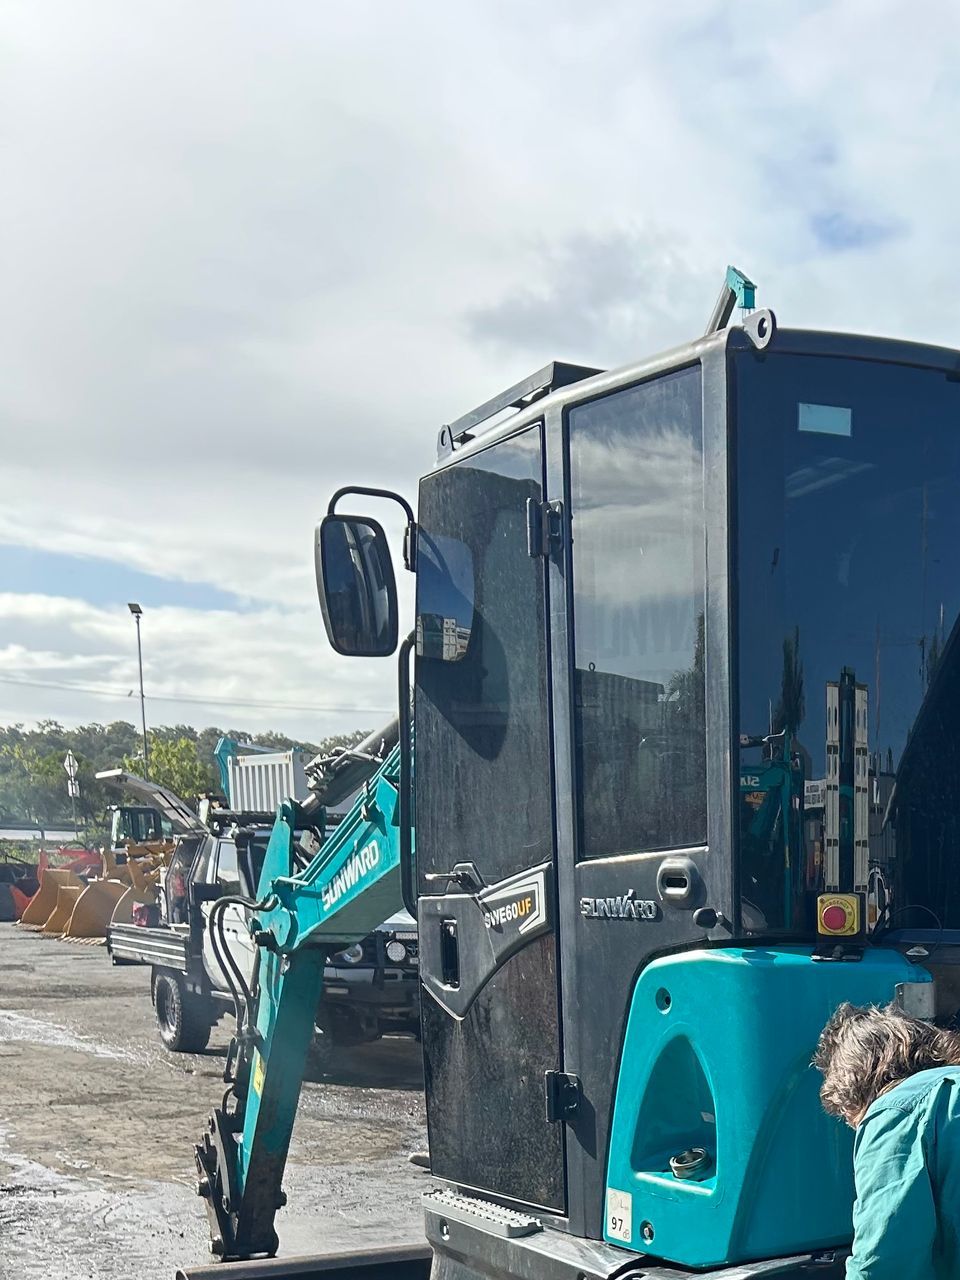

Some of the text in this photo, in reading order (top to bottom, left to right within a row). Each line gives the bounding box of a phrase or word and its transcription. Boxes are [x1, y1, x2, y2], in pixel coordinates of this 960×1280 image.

[321, 839, 380, 911] SUNWARD
[484, 897, 531, 928] SWE60UF
[580, 888, 657, 919] SUNWARD
[611, 1216, 623, 1232] 97
